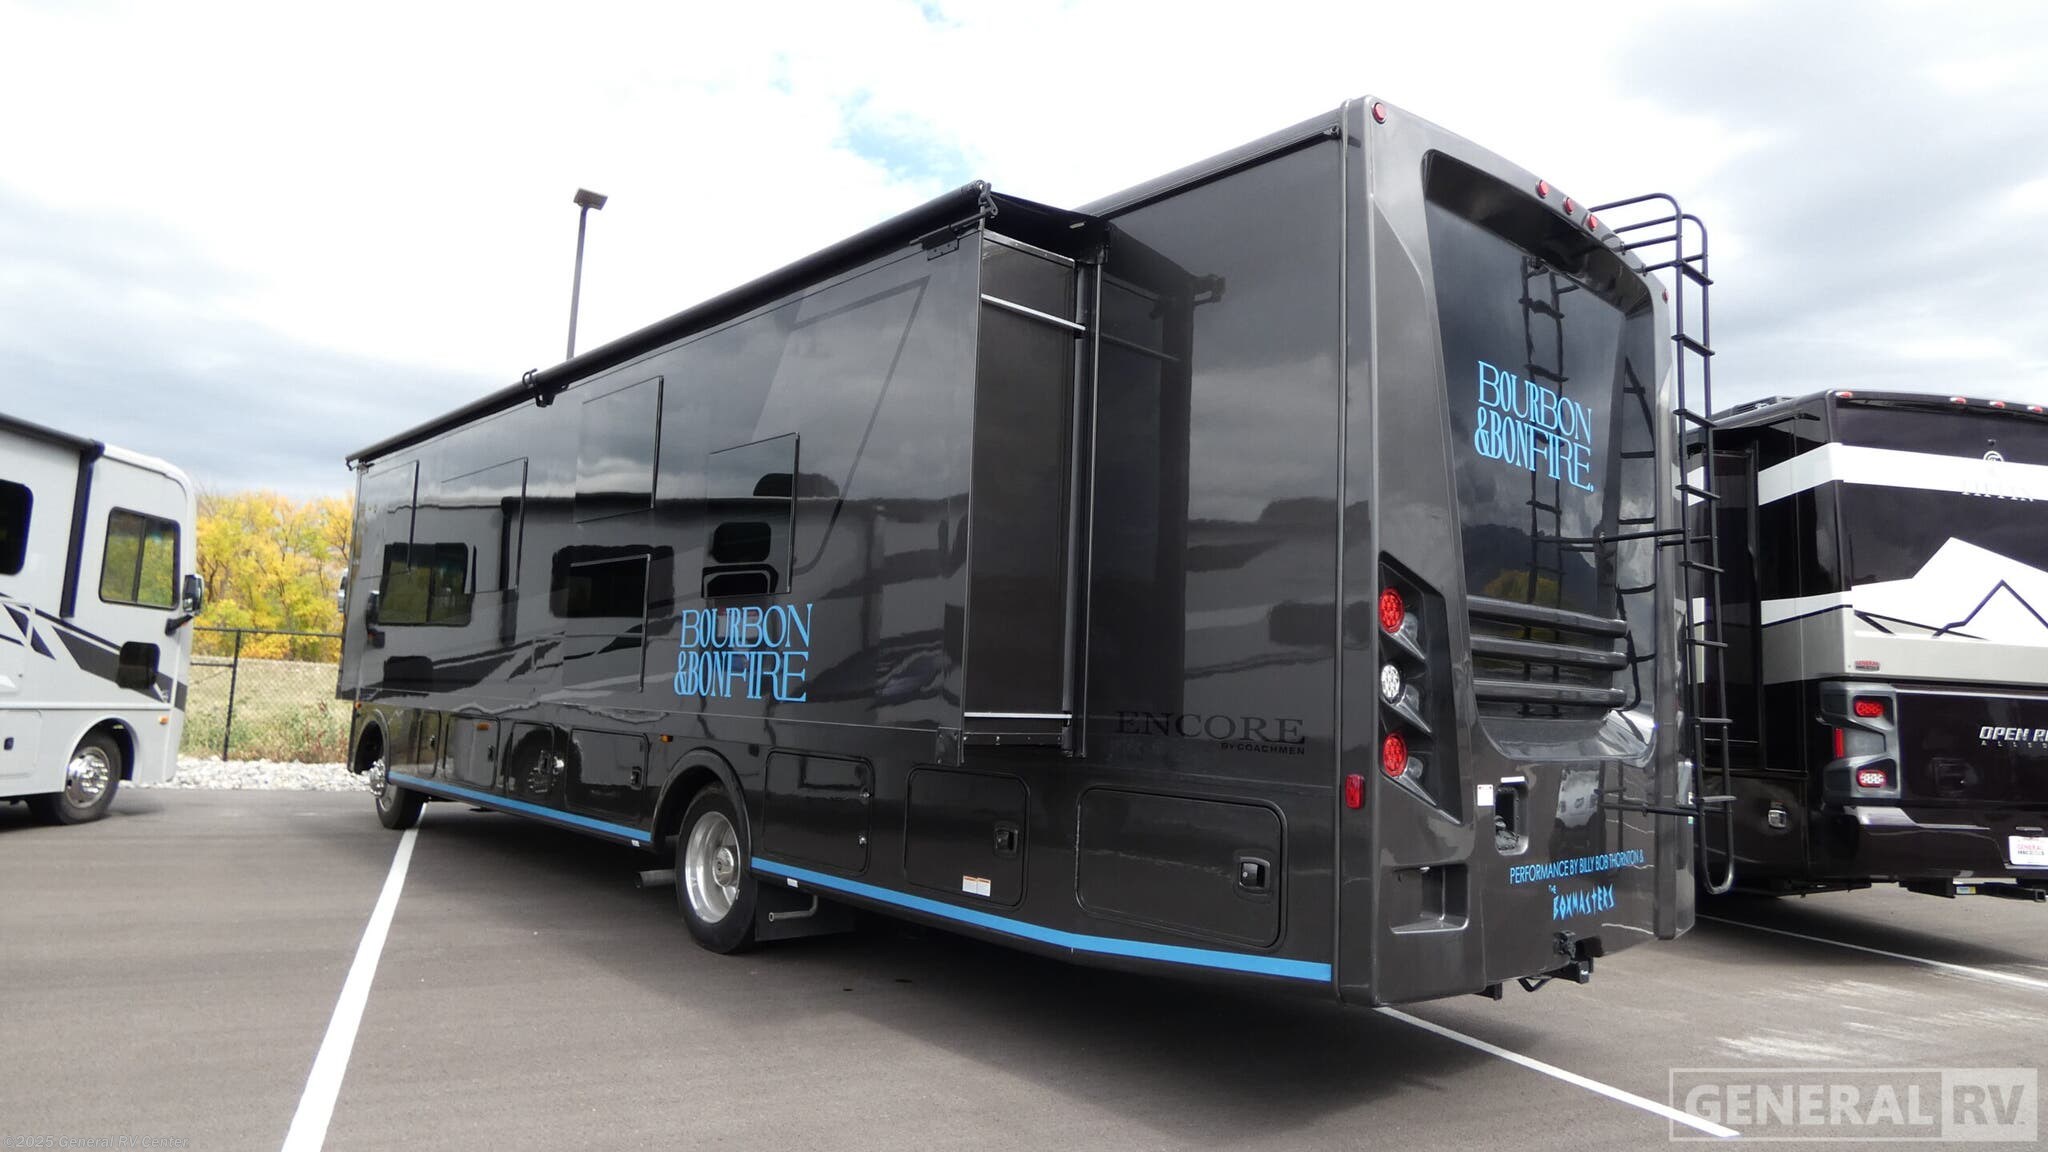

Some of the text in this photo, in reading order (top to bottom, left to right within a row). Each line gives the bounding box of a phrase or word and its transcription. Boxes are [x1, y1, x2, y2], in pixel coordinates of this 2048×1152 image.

[1478, 360, 1592, 444] BOURBON
[680, 603, 813, 649] BOURBON
[1114, 710, 1305, 745] ENCORE
[1979, 726, 2048, 742] OPEN R
[1221, 742, 1305, 756] BY COACHMEN
[1510, 849, 1644, 884] PERFORMANCE BY BILLY BOB THORNTON &
[1553, 883, 1615, 920] BOXMASTERS
